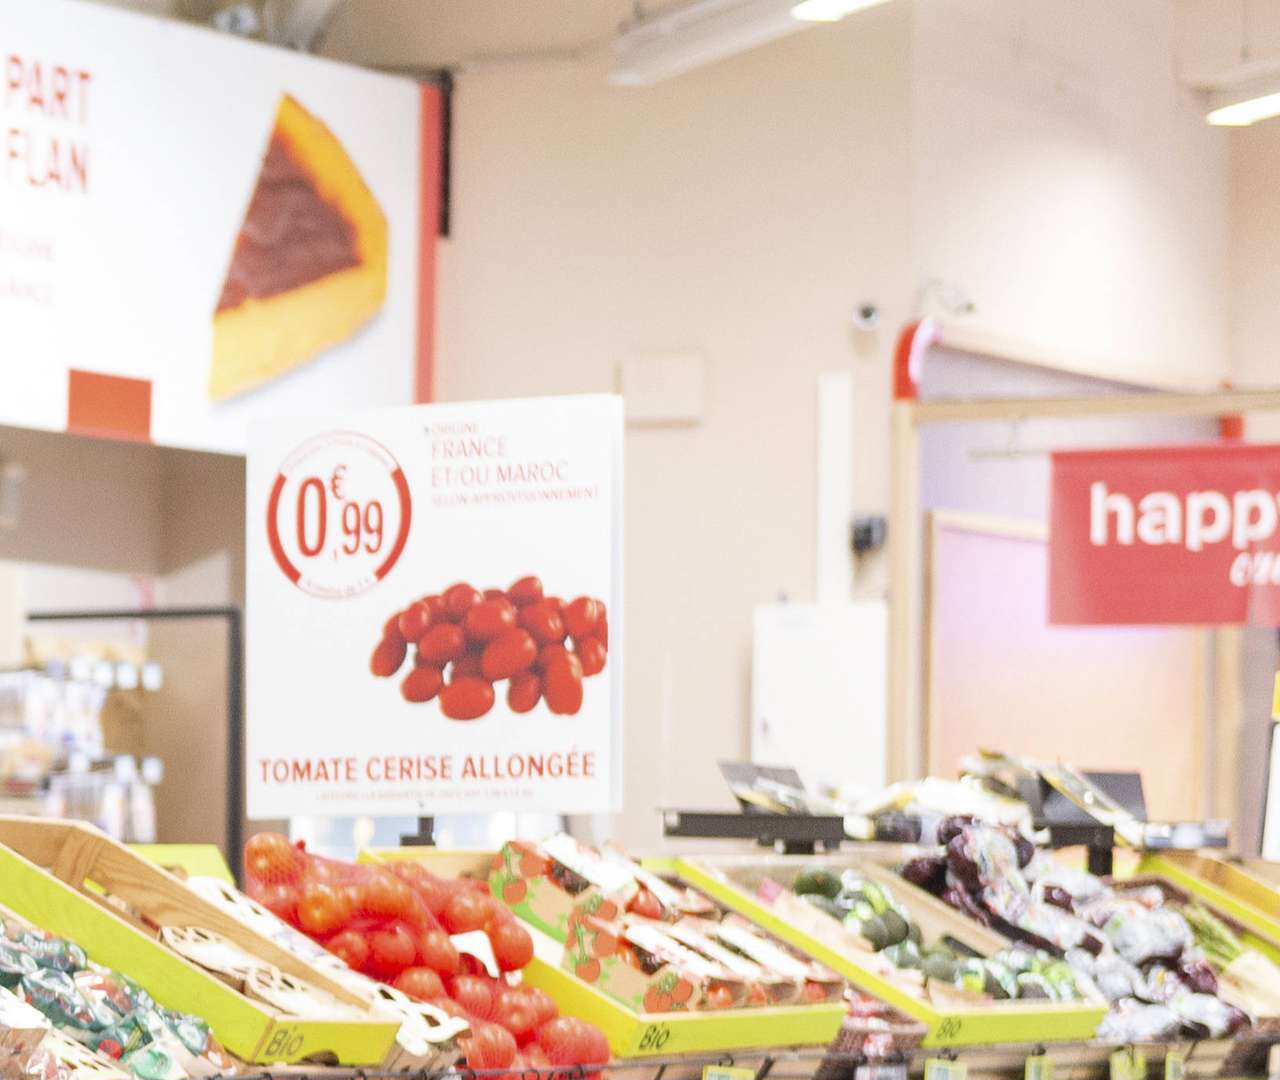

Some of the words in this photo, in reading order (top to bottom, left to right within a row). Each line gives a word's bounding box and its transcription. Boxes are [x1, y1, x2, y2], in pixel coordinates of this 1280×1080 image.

[4, 53, 96, 126] PART
[4, 127, 92, 193] FLAN
[1090, 481, 1280, 551] happ
[258, 757, 358, 785] TOMATE
[366, 755, 453, 782] CERISE
[461, 746, 597, 781] ALLONGÉE
[265, 1025, 305, 1056] Bio
